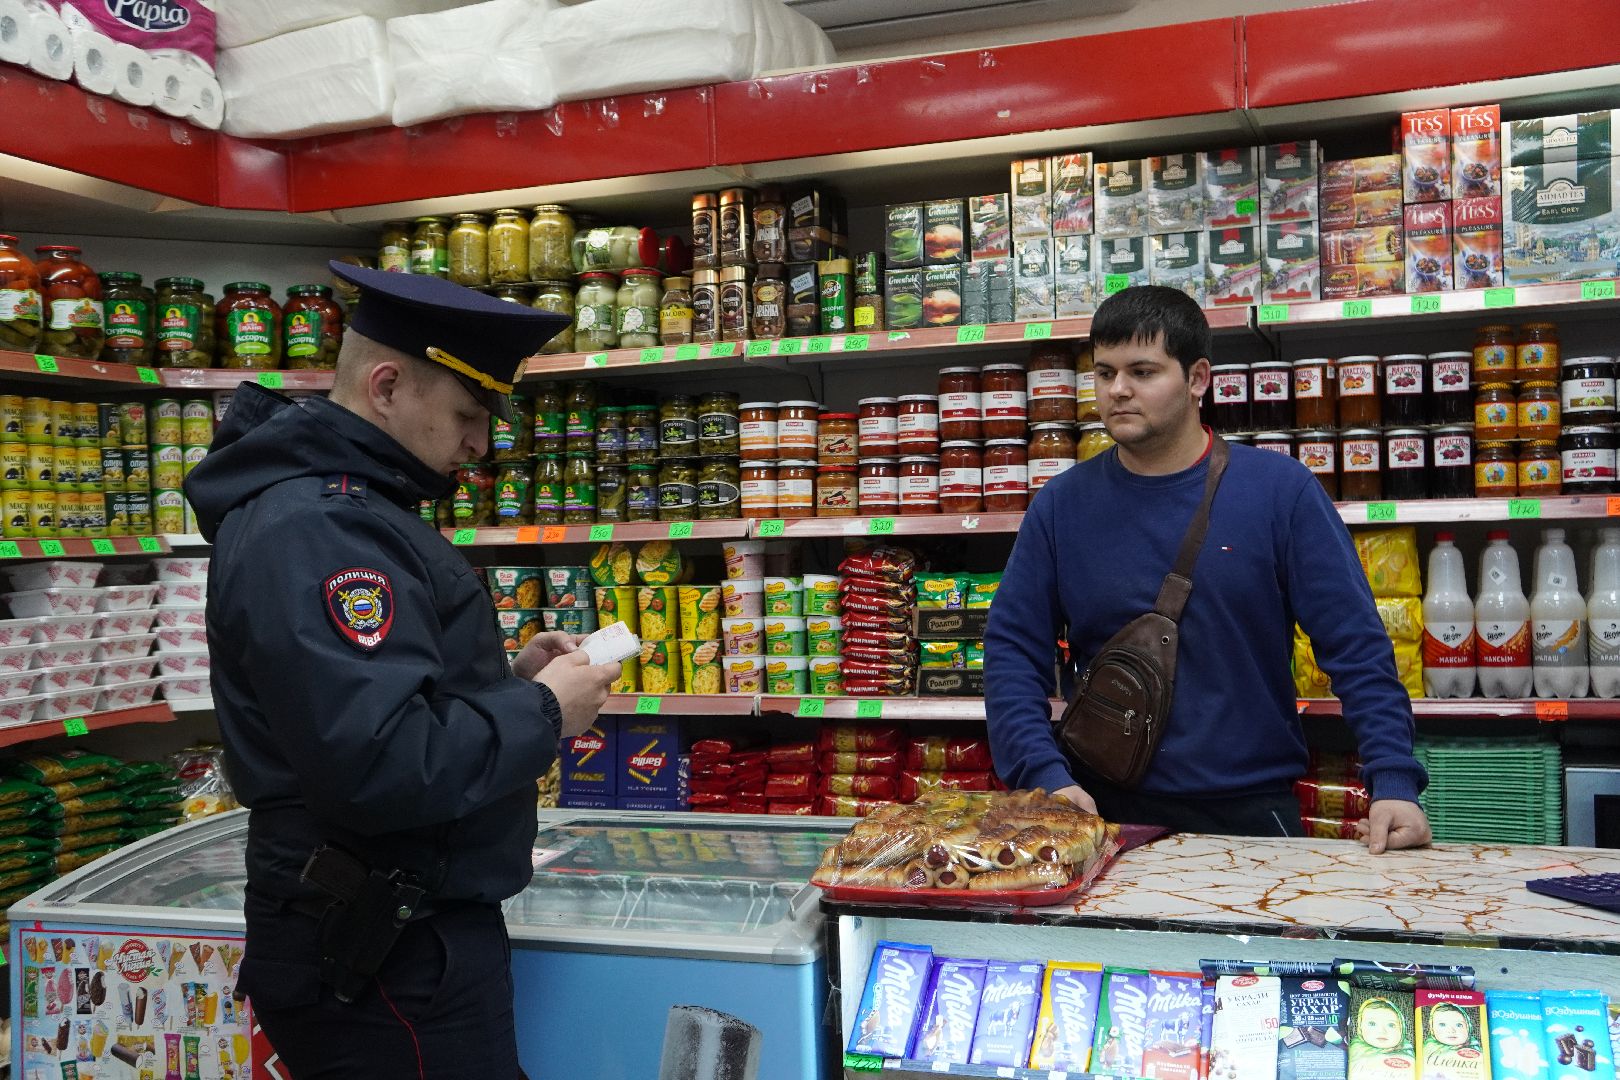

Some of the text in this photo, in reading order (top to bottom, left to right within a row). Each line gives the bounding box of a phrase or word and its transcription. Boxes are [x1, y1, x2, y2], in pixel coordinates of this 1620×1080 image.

[113, 0, 186, 29] Papia
[1408, 116, 1443, 133] TESS
[1457, 112, 1494, 130] TESS
[1539, 192, 1584, 202] AHMAD TEA
[928, 207, 959, 217] Greenfield
[1412, 207, 1446, 225] TESS
[1460, 204, 1495, 221] TESS
[1461, 226, 1493, 234] PLEASURE
[888, 275, 918, 285] Greenfield
[926, 270, 956, 281] Greenfield
[661, 310, 687, 318] JACOBS
[106, 327, 143, 336] Огурчики
[236, 335, 269, 343] Ассорти
[288, 336, 316, 345] Ассорти
[845, 340, 865, 350] 295
[764, 523, 782, 534] 320
[874, 522, 891, 532] 320
[329, 571, 386, 591] ПОЛИЦИЯ
[357, 631, 382, 647] МВД
[1439, 656, 1469, 664] МАКСЫМ
[1484, 656, 1514, 664] МАКСЫМ
[573, 739, 603, 749] Barilla
[630, 756, 662, 767] Barilla
[880, 957, 916, 1030] Milka
[981, 980, 1035, 1003] Milka
[940, 972, 976, 1044] Milka
[1147, 992, 1202, 1013] Milka
[1290, 998, 1339, 1007] УКРАЛИ
[1053, 977, 1089, 1042] Milka
[1291, 1005, 1339, 1015] САХАР
[1110, 984, 1148, 1058] Milka
